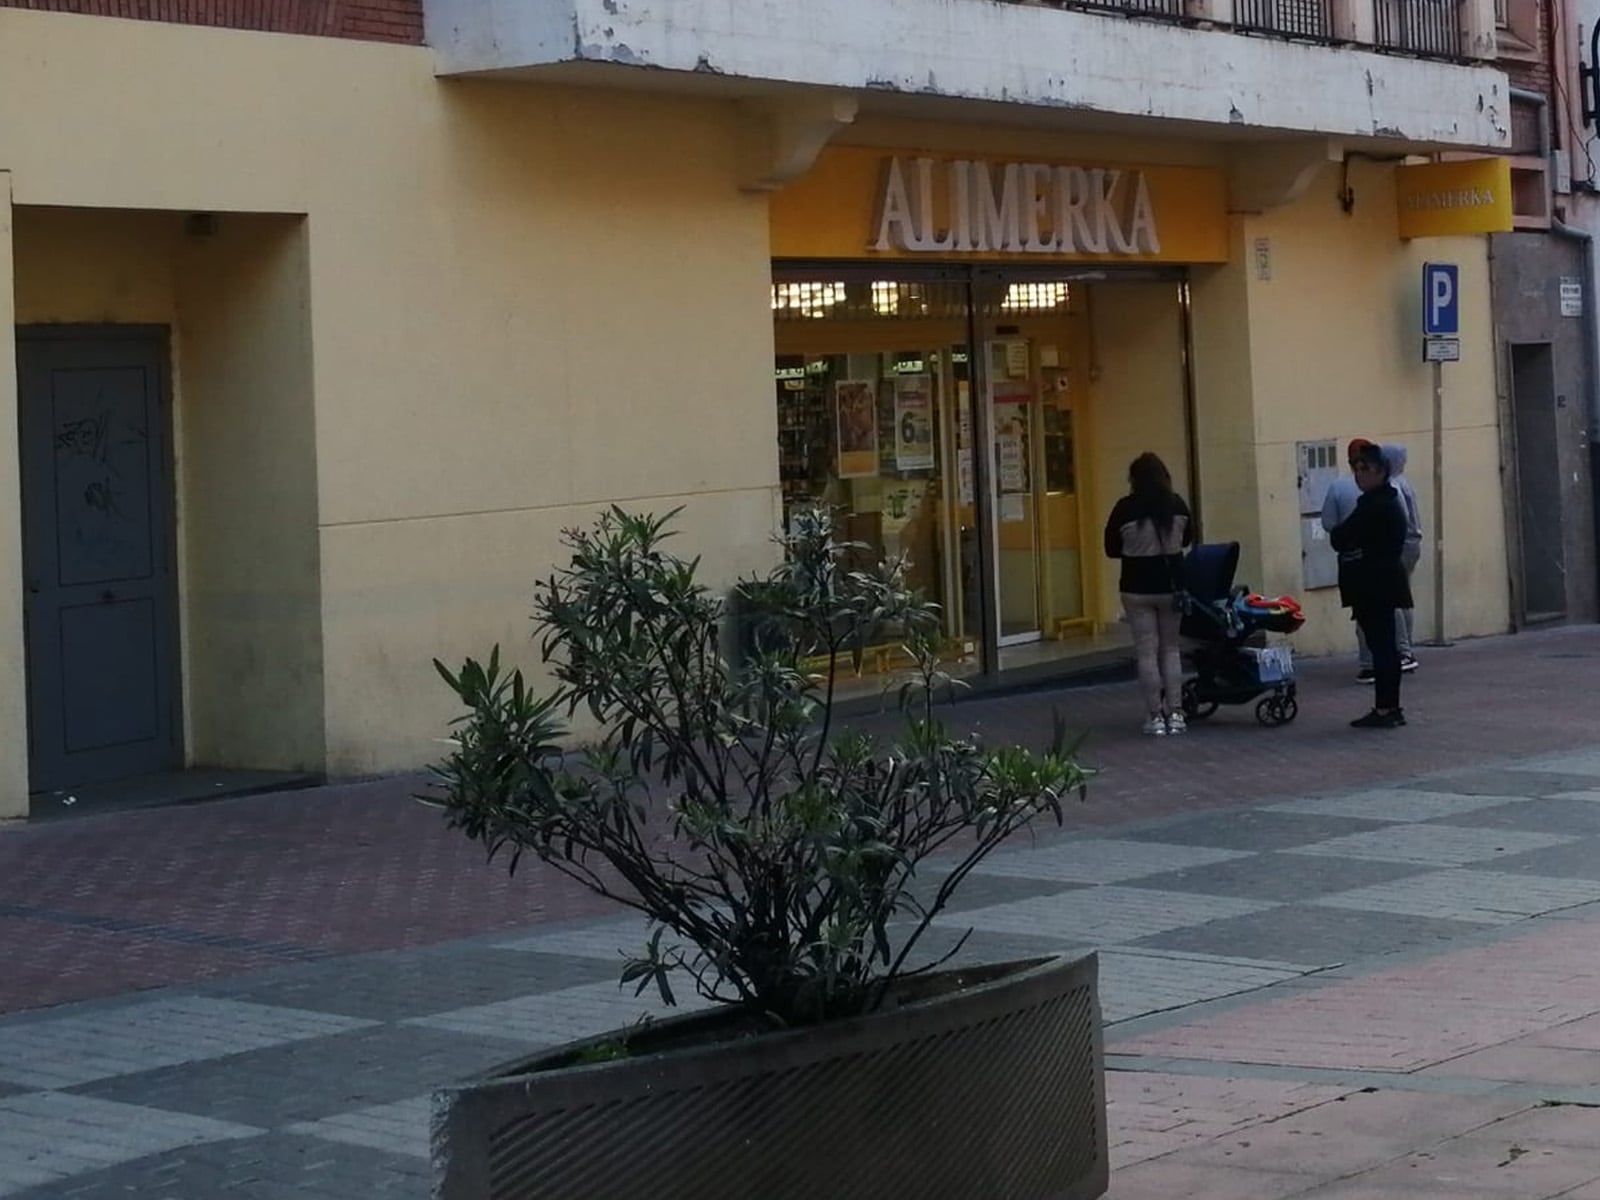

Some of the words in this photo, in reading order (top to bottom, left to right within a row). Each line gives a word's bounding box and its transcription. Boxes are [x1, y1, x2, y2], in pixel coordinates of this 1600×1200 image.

[868, 154, 1162, 256] ALIMERKA
[1432, 271, 1453, 327] P
[901, 410, 915, 444] 6
